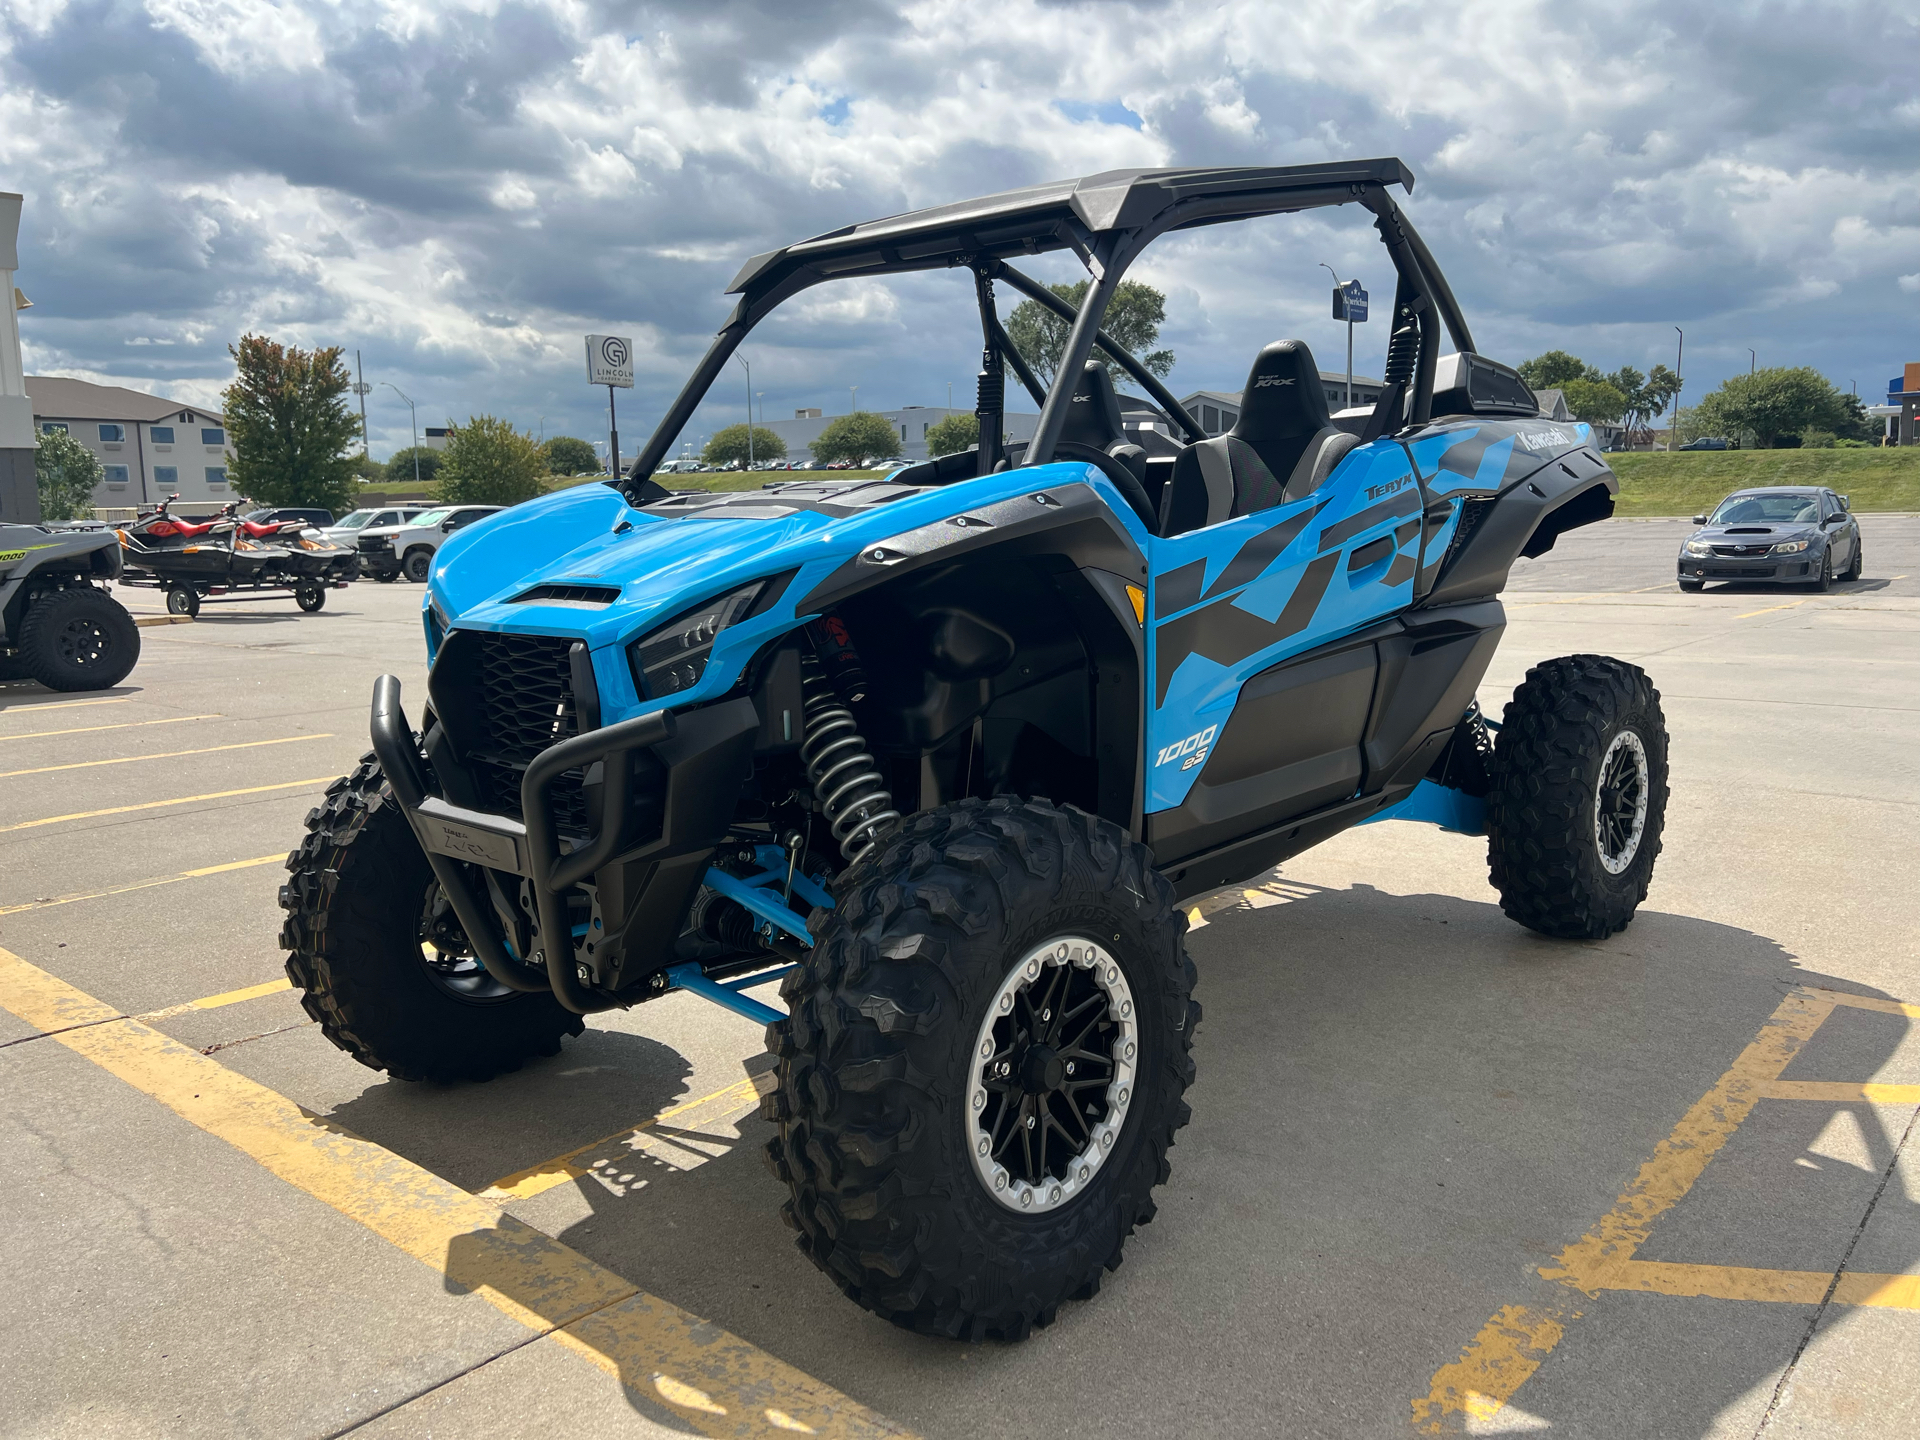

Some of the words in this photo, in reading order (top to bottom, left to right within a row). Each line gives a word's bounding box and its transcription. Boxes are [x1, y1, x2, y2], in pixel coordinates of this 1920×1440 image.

[597, 368, 633, 378] LINCOLN
[1254, 378, 1296, 388] KRX
[1516, 427, 1571, 452] Kawasaki
[1364, 473, 1413, 501] TERYX
[1154, 723, 1218, 768] 1000
[1012, 905, 1118, 953] CARNIVORE
